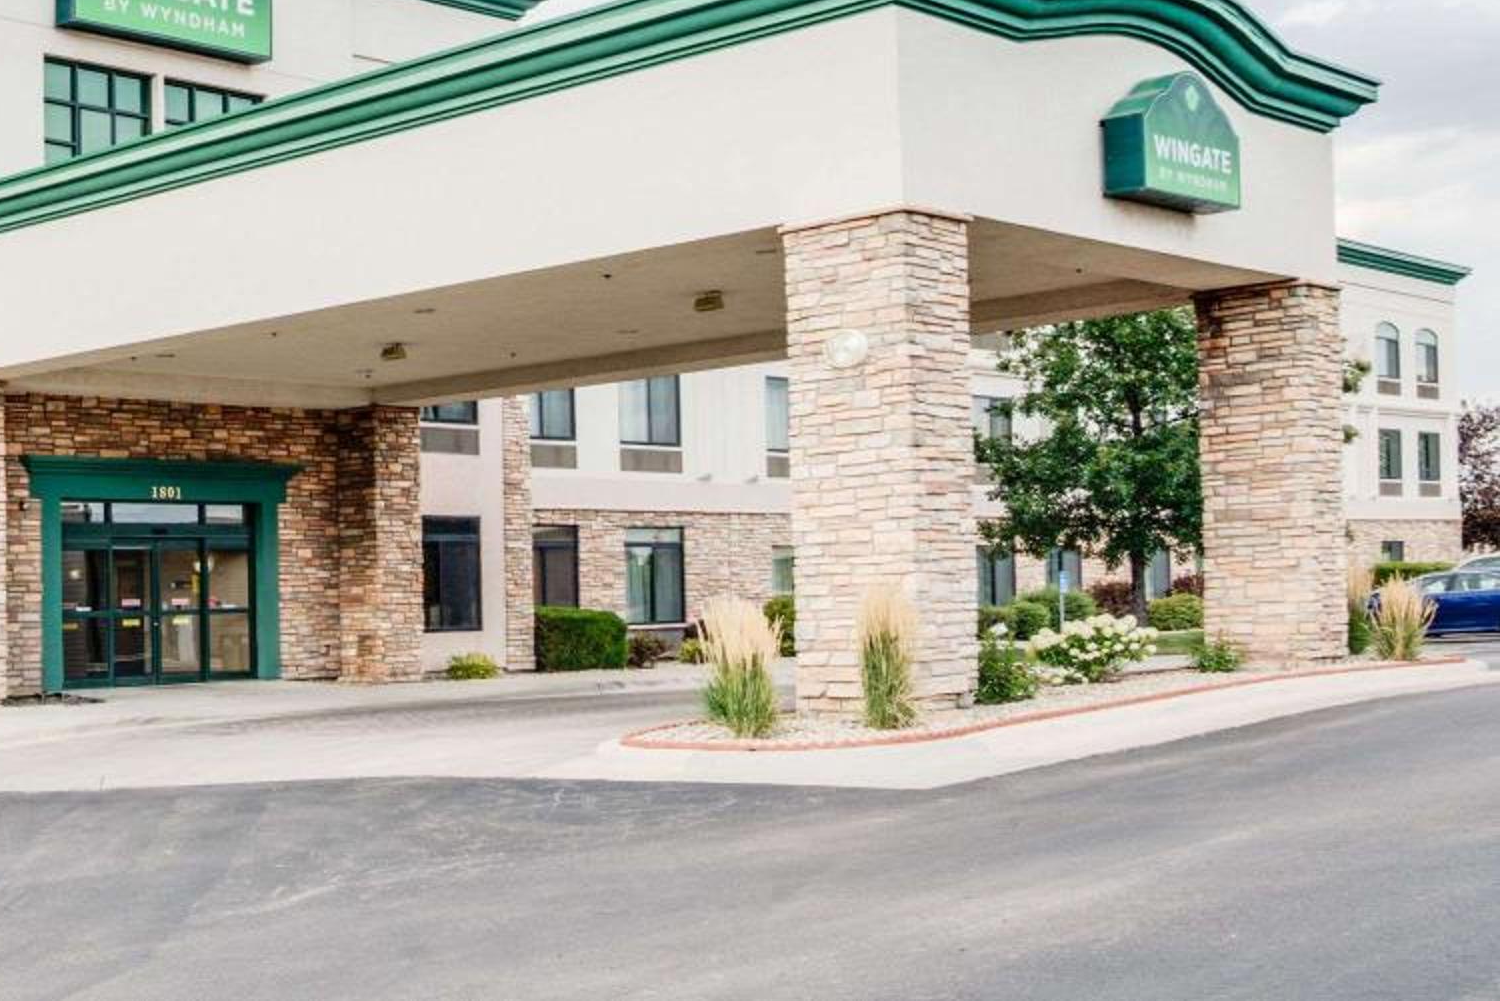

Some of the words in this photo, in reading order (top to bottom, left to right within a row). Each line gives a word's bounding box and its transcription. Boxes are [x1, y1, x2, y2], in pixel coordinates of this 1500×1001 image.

[140, 2, 245, 38] WYNDHAM
[1153, 133, 1232, 174] WINGATE
[151, 486, 181, 499] 1801
